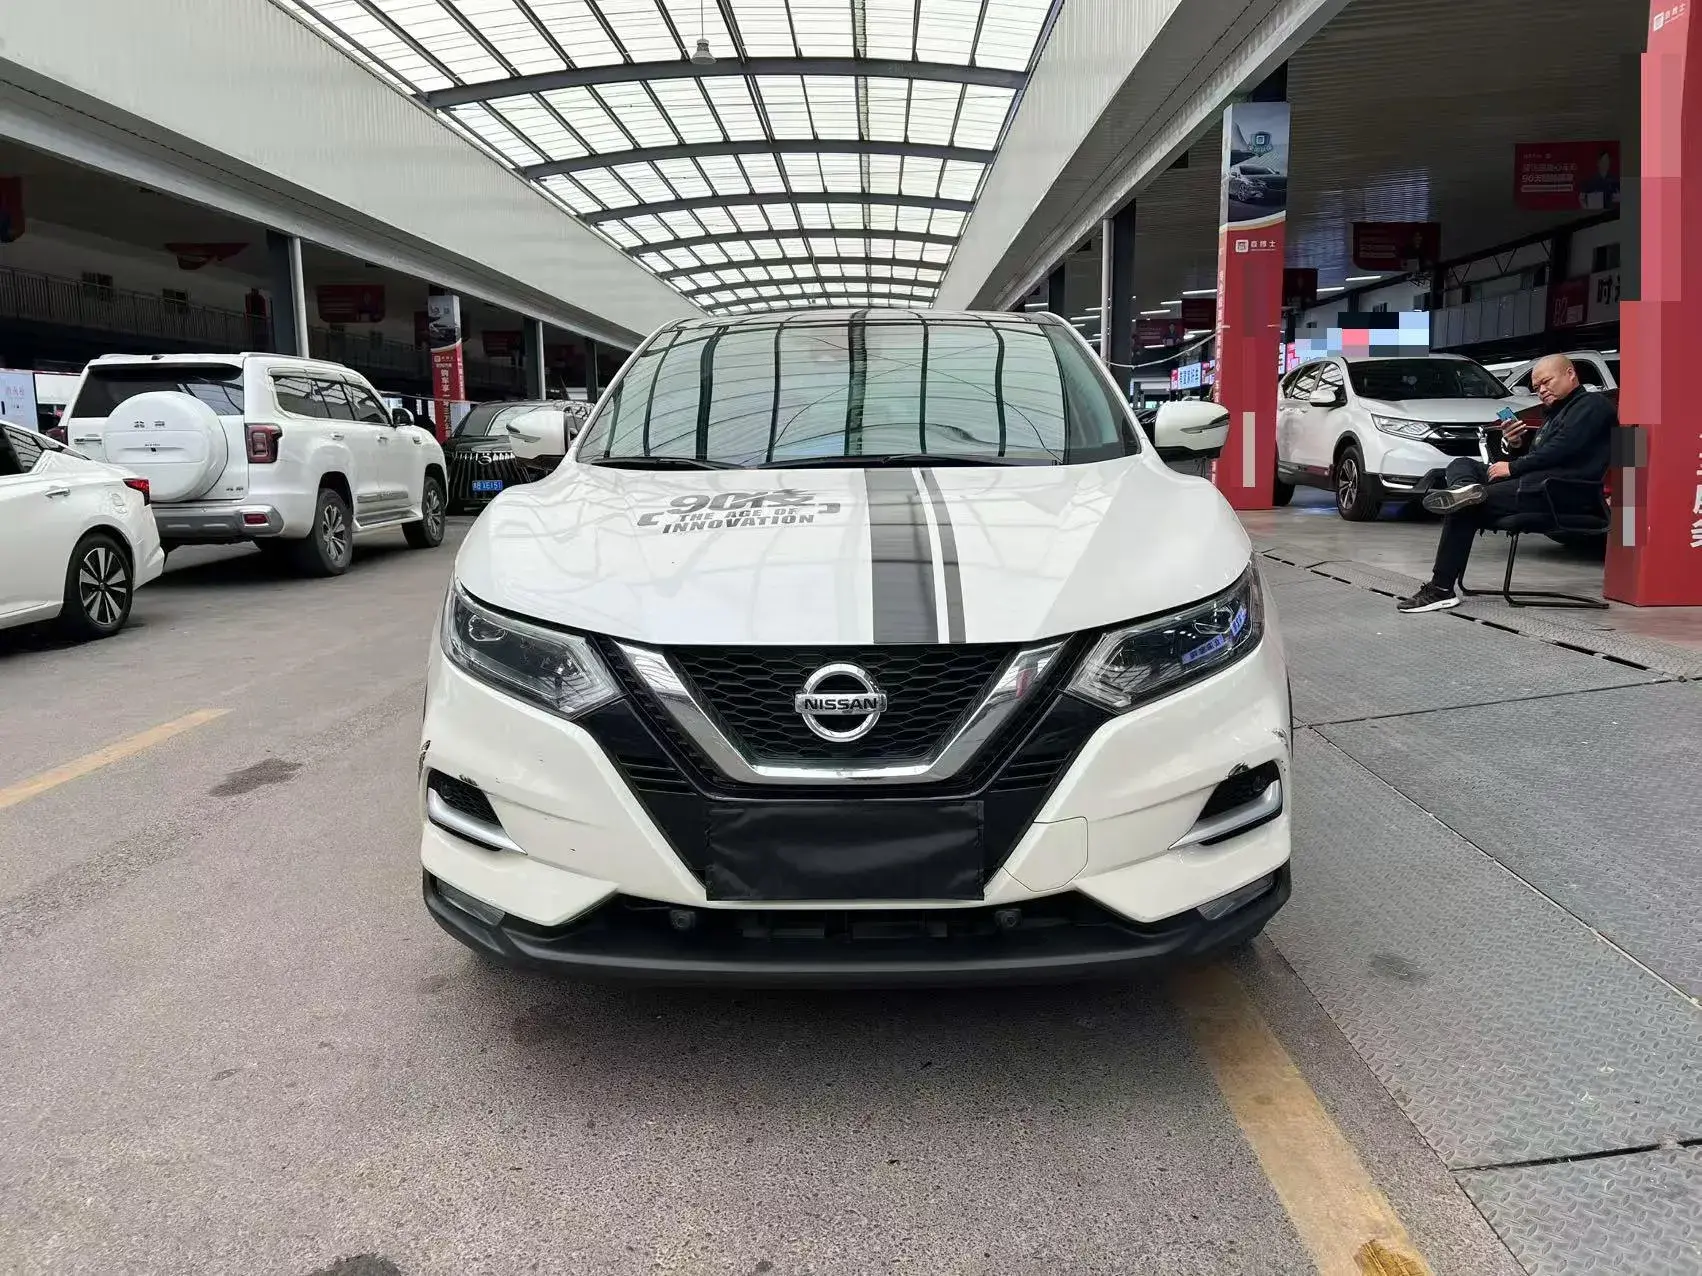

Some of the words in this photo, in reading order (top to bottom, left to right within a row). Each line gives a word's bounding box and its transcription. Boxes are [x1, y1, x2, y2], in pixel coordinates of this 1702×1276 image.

[679, 512, 714, 523] THE
[724, 509, 762, 519] AGE
[774, 507, 799, 516] OF
[662, 514, 815, 534] INNOVATION
[804, 697, 878, 711] NISSAN
